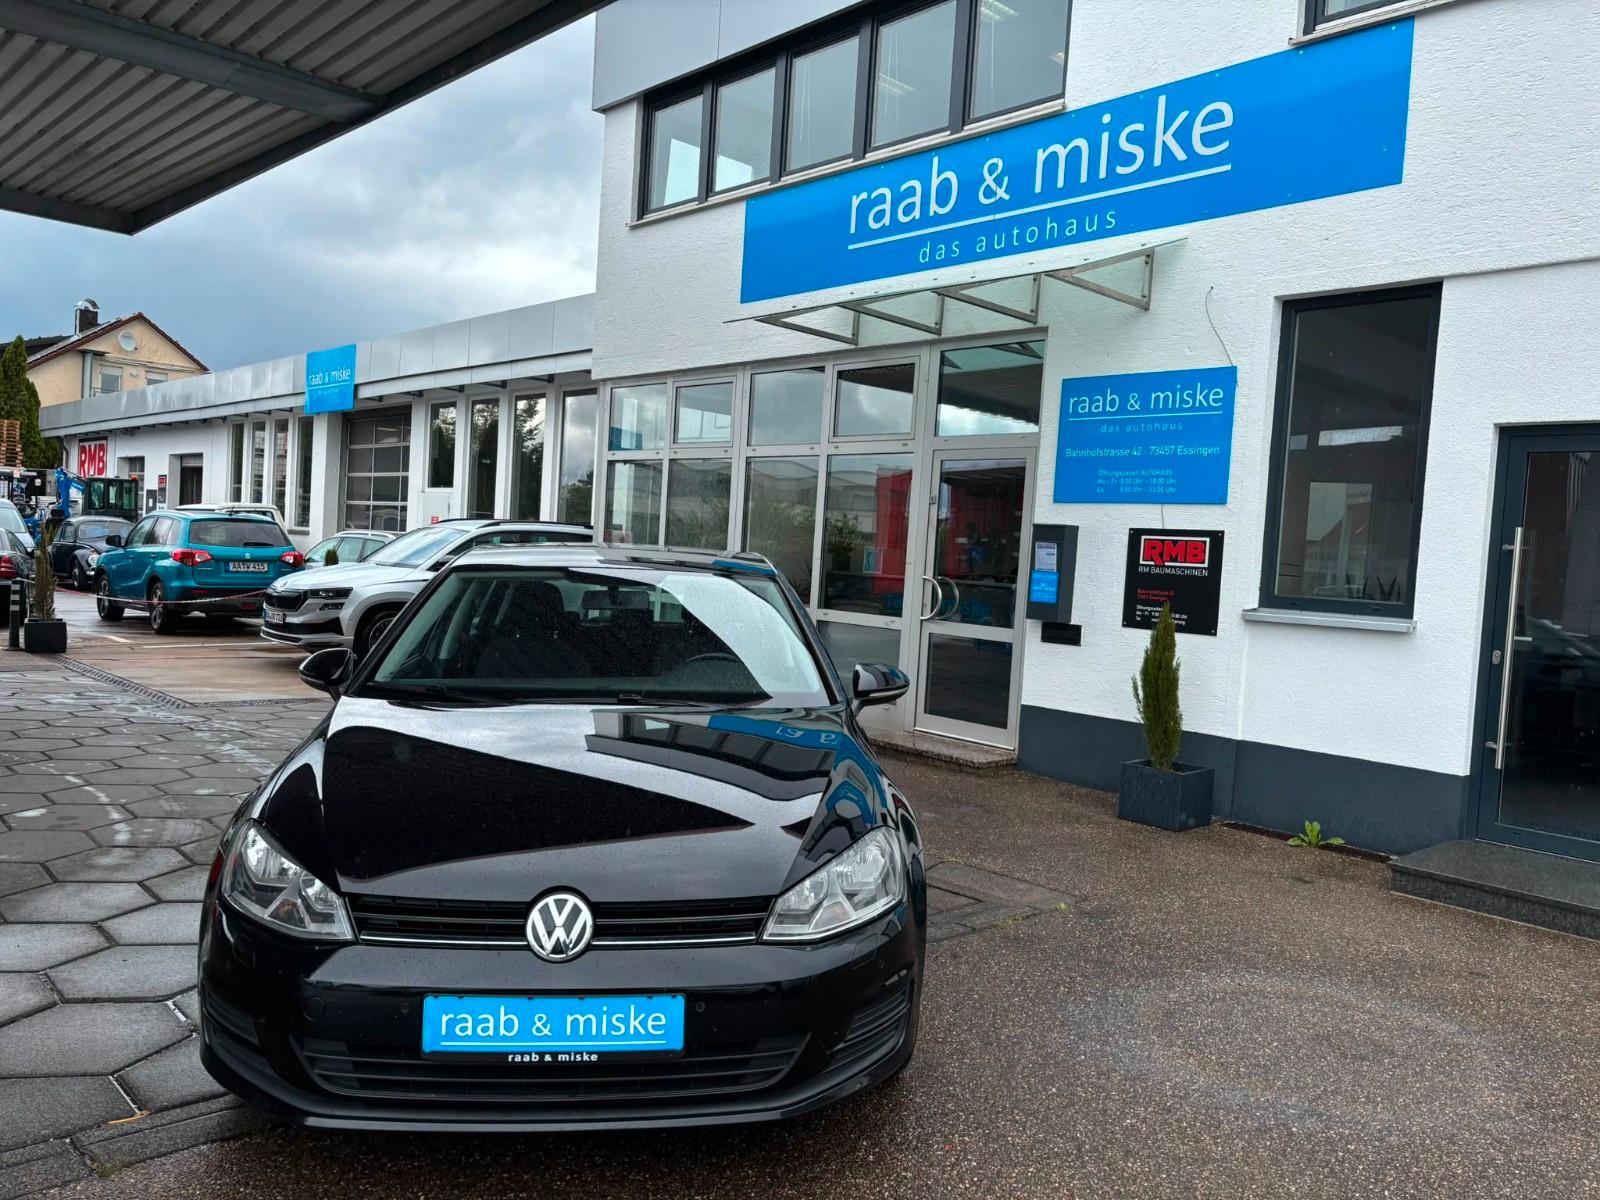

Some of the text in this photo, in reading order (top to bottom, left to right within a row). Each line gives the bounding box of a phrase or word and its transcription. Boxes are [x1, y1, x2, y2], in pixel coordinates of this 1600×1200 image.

[850, 95, 1234, 234] raab & miske
[919, 210, 1117, 264] das autohaus
[309, 369, 323, 385] raab
[331, 365, 351, 381] miske
[1069, 382, 1224, 414] raab & miske
[1101, 421, 1183, 433] das autohaus
[80, 443, 106, 479] RMB
[1066, 445, 1220, 458] Bahnhofstrasse 42 73457 Essingen
[1143, 540, 1205, 566] RMB
[1138, 565, 1208, 577] RM BAUMASCHINEN
[441, 1004, 666, 1037] raab & miske
[508, 1052, 598, 1062] raab & miske
